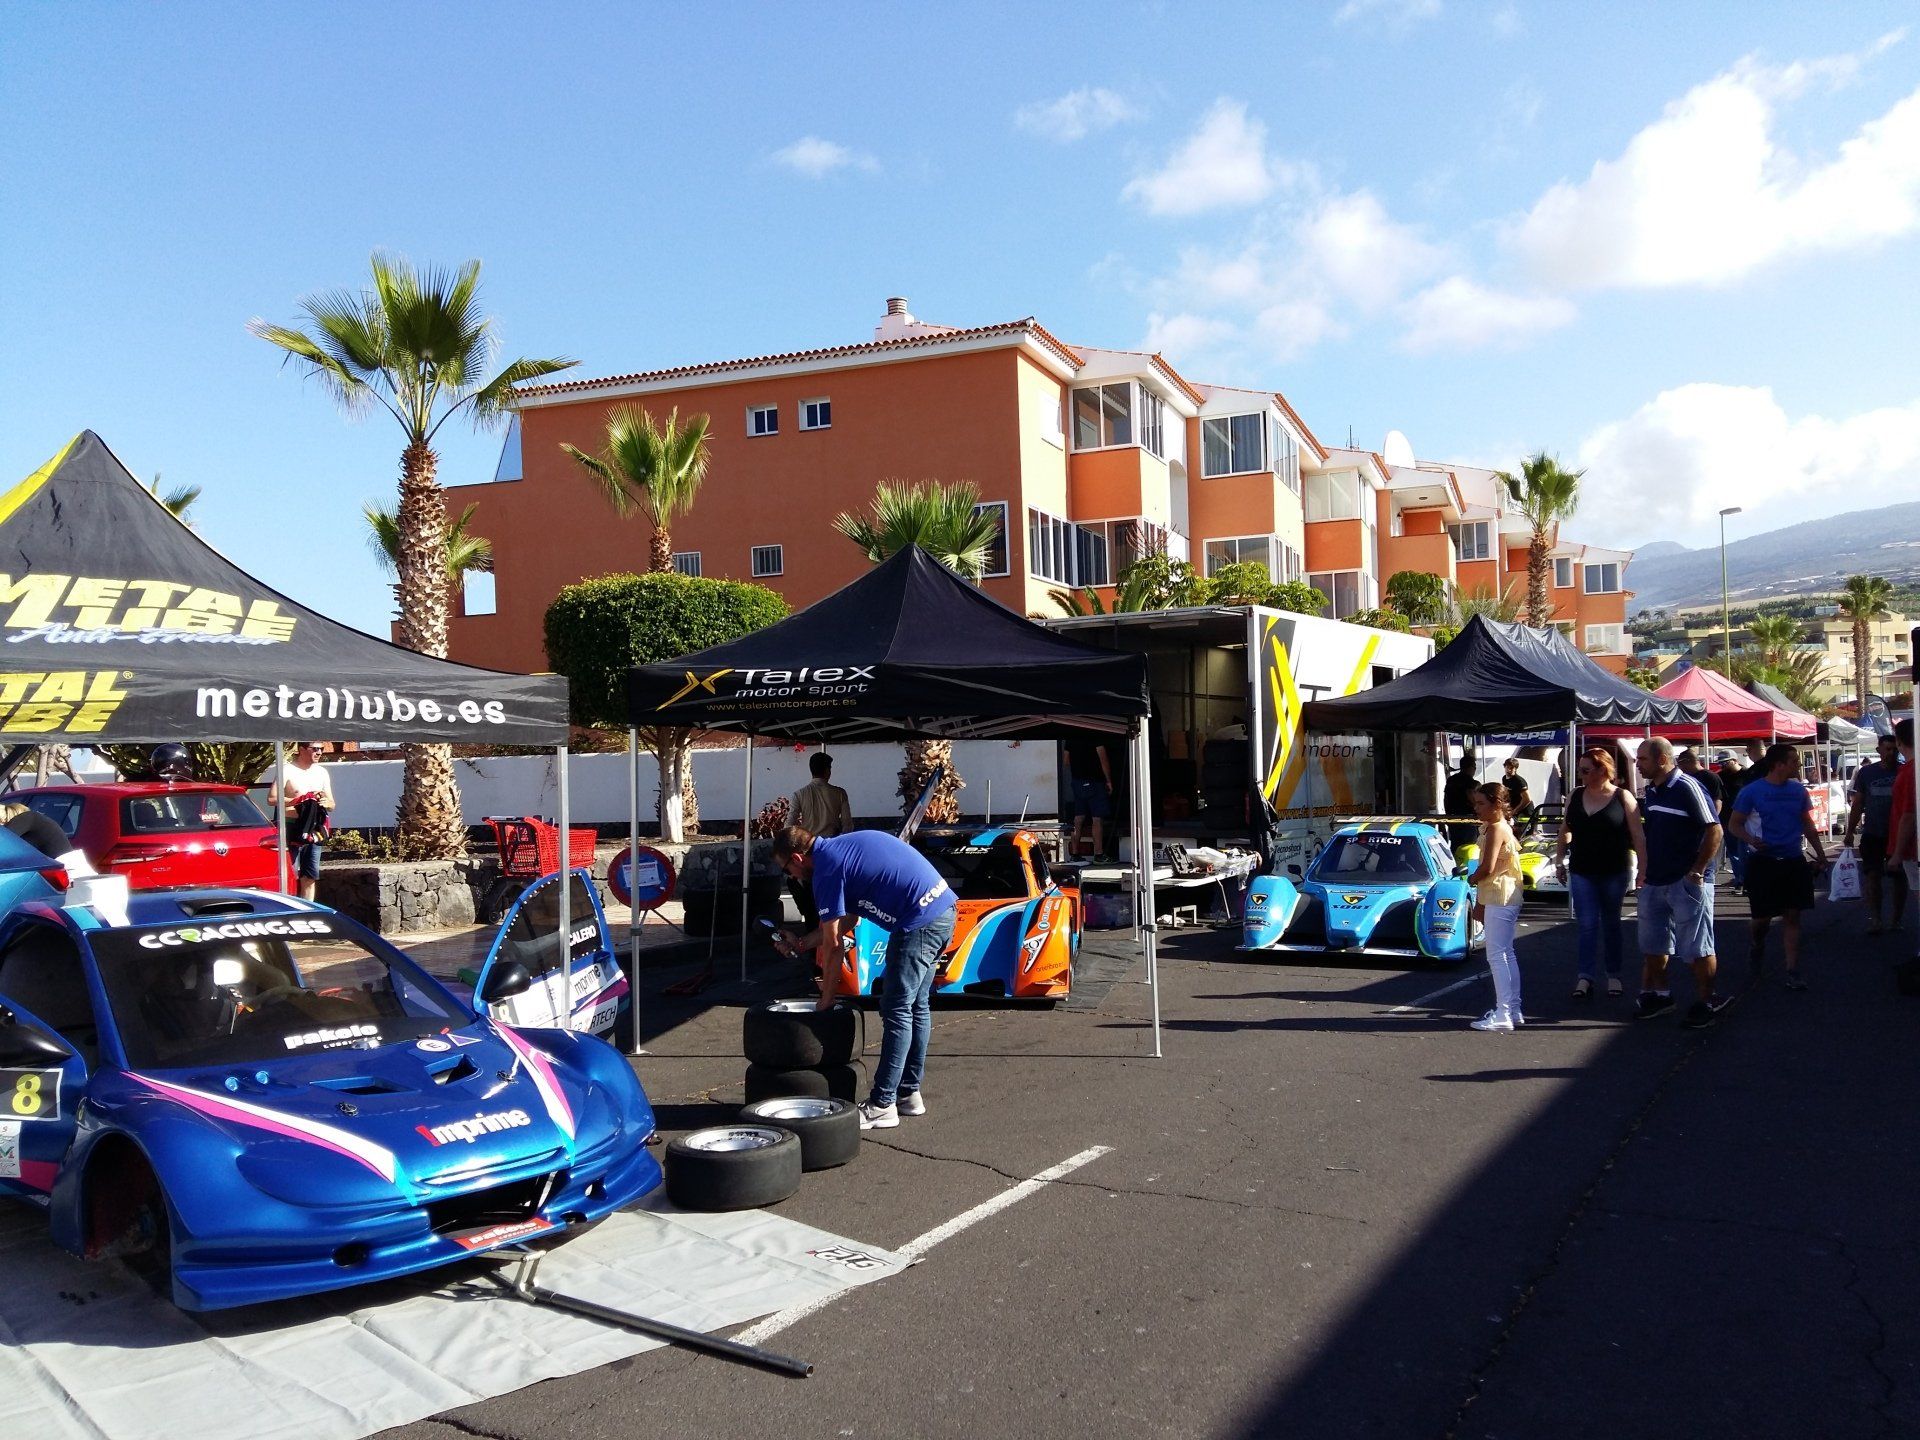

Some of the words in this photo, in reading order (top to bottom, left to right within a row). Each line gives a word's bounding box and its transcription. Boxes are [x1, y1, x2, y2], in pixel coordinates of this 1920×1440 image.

[734, 665, 877, 685] Talex
[735, 686, 801, 698] motor
[808, 683, 868, 695] sport
[195, 684, 507, 724] metallube.es
[1505, 731, 1556, 741] PEPSI
[138, 920, 332, 949] CCRACING.ES
[283, 1024, 379, 1050] pakelo
[11, 1073, 42, 1115] 8
